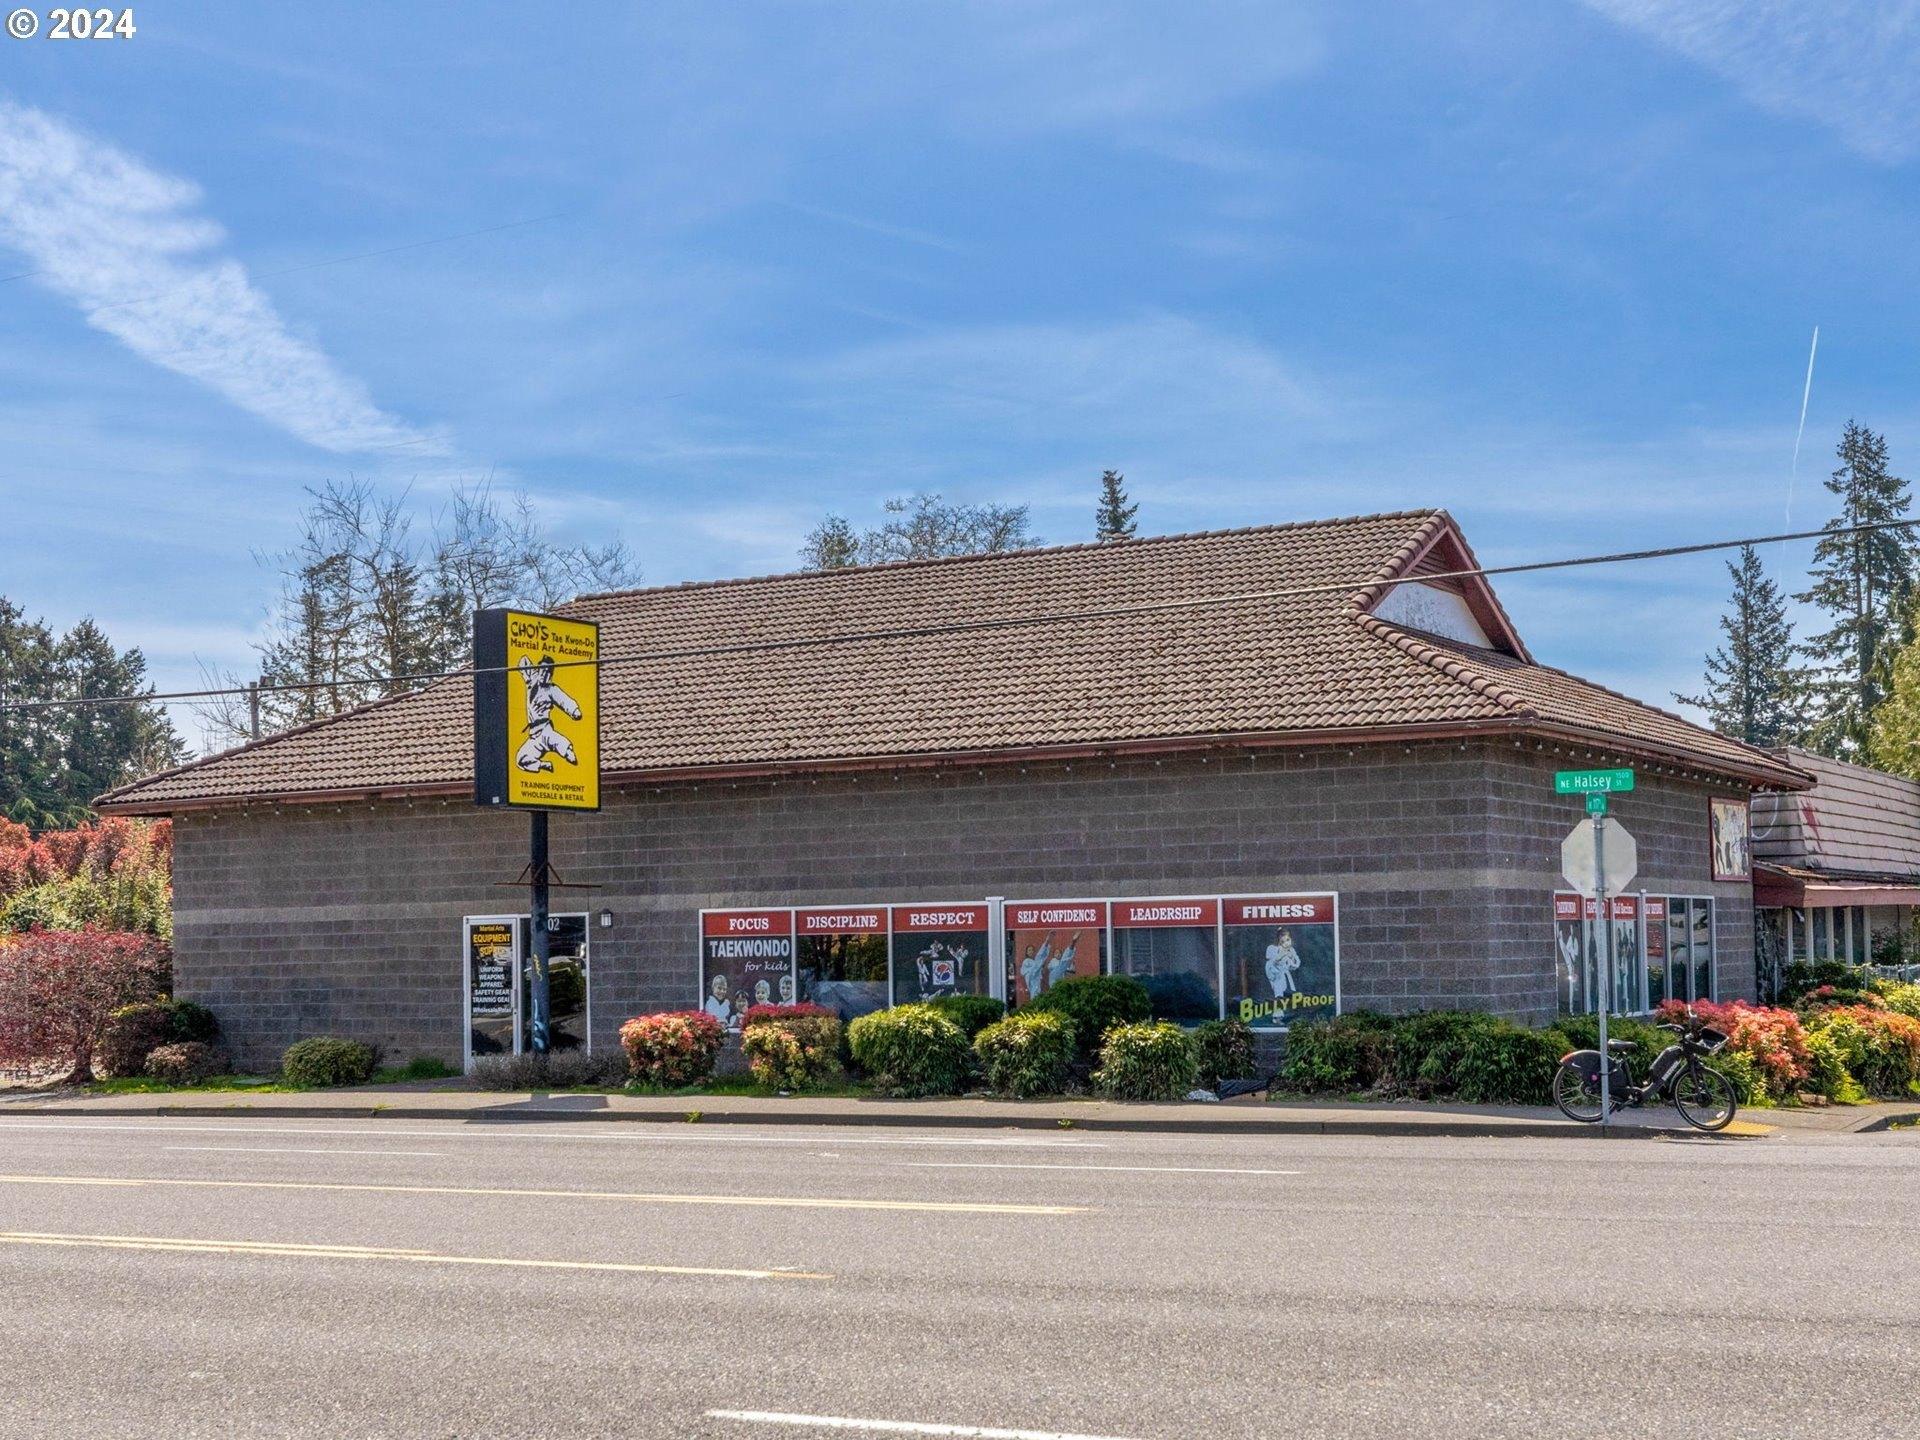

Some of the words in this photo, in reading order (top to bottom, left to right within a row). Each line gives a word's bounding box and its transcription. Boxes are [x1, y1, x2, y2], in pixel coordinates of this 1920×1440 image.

[510, 621, 549, 641] CHOI'S
[551, 632, 563, 643] Tae
[565, 635, 595, 648] Kwon-Do
[510, 638, 539, 650] Martial
[541, 642, 556, 653] Art
[558, 645, 594, 661] Academy
[521, 781, 551, 790] TRAINING
[552, 783, 585, 792] EQUIPMENT
[1560, 779, 1571, 788] NE
[1574, 775, 1612, 789] Halsey
[521, 791, 558, 800] WHOLESALE
[565, 794, 585, 802] RETAIL
[1017, 909, 1039, 924] SELF
[1040, 909, 1096, 923] CONFIDENCE
[1130, 906, 1202, 921] LEADERSHIP
[1242, 904, 1315, 919] FITNESS
[729, 918, 769, 931] FOCUS
[806, 915, 878, 929] DISCIPLINE
[910, 912, 975, 926] RESPECT
[473, 933, 511, 943] EQUIPMENT
[709, 939, 790, 958] TAEKWONDO
[744, 960, 761, 973] for
[764, 960, 790, 972] kids
